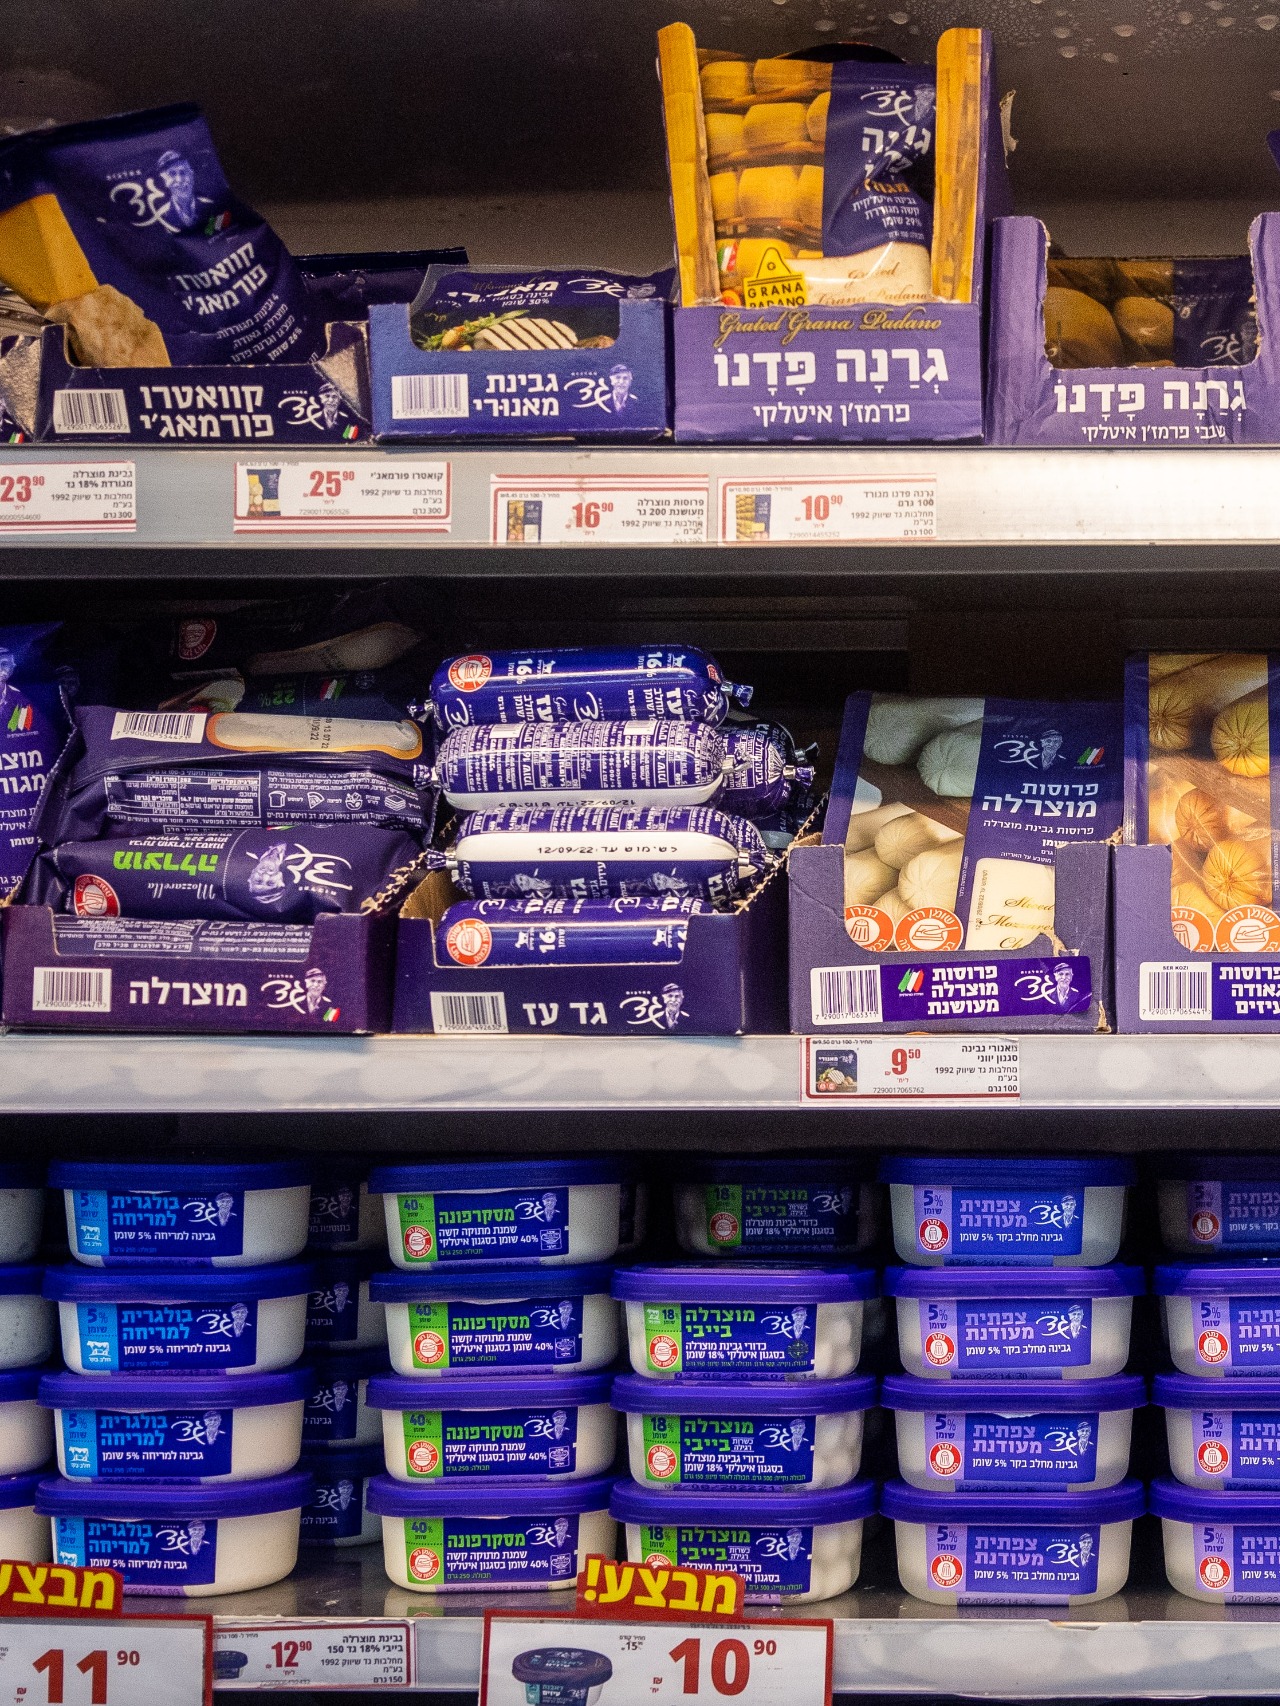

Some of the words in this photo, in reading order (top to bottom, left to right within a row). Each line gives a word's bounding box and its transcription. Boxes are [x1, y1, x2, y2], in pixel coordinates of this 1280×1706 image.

[747, 282, 804, 298] GRANA
[860, 308, 941, 333] Padano
[486, 373, 559, 394] גבינת
[140, 385, 265, 409] קוואטרו
[753, 402, 833, 427] איטלקי
[139, 412, 274, 438] פורמאג'י
[1, 476, 32, 503] 23
[33, 476, 45, 486] 90
[309, 471, 341, 497] 25
[343, 471, 355, 480] 90
[637, 499, 670, 507] מוצרלה
[673, 499, 705, 507] פרוסות
[801, 495, 830, 521] 10
[831, 494, 843, 505] 90
[572, 502, 600, 528] 16
[602, 502, 614, 512] 90
[1022, 782, 1099, 797] פרוסות
[982, 794, 1097, 818] מוצרלה
[113, 851, 219, 876] מוצרלה
[933, 965, 998, 981] פרוסות
[130, 976, 248, 1007] מוצרלה
[932, 981, 998, 998] מוצרלה
[523, 1002, 559, 1028] עז
[571, 1002, 607, 1024] גד
[927, 1001, 1000, 1016] מעושנת
[892, 1048, 908, 1075] 9
[908, 1049, 921, 1059] 50
[997, 1055, 1018, 1063] סגנון
[121, 1308, 193, 1324] בולגרית
[686, 1308, 755, 1322] מוצרלה
[122, 1326, 190, 1340] למריחה
[686, 1325, 732, 1339] בייבי
[124, 1345, 147, 1355] שומן
[149, 1345, 164, 1354] 5%
[166, 1344, 203, 1354] למריחה
[204, 1344, 231, 1353] גבינה
[447, 1425, 525, 1442] מסקרפונה
[975, 1536, 1038, 1550] צפתית
[974, 1552, 1044, 1566] מעודנת
[974, 1570, 994, 1580] שומן
[996, 1571, 1009, 1580] 5%
[1011, 1571, 1029, 1580] בקר
[1032, 1571, 1055, 1580] מחלב
[1057, 1571, 1080, 1581] גבינה
[585, 1558, 739, 1616] מבצע!
[272, 1641, 299, 1668] 12
[300, 1641, 312, 1651] 90
[669, 1637, 751, 1696] 10
[753, 1639, 778, 1657] 90
[33, 1648, 109, 1705] 11
[116, 1650, 141, 1667] 90
